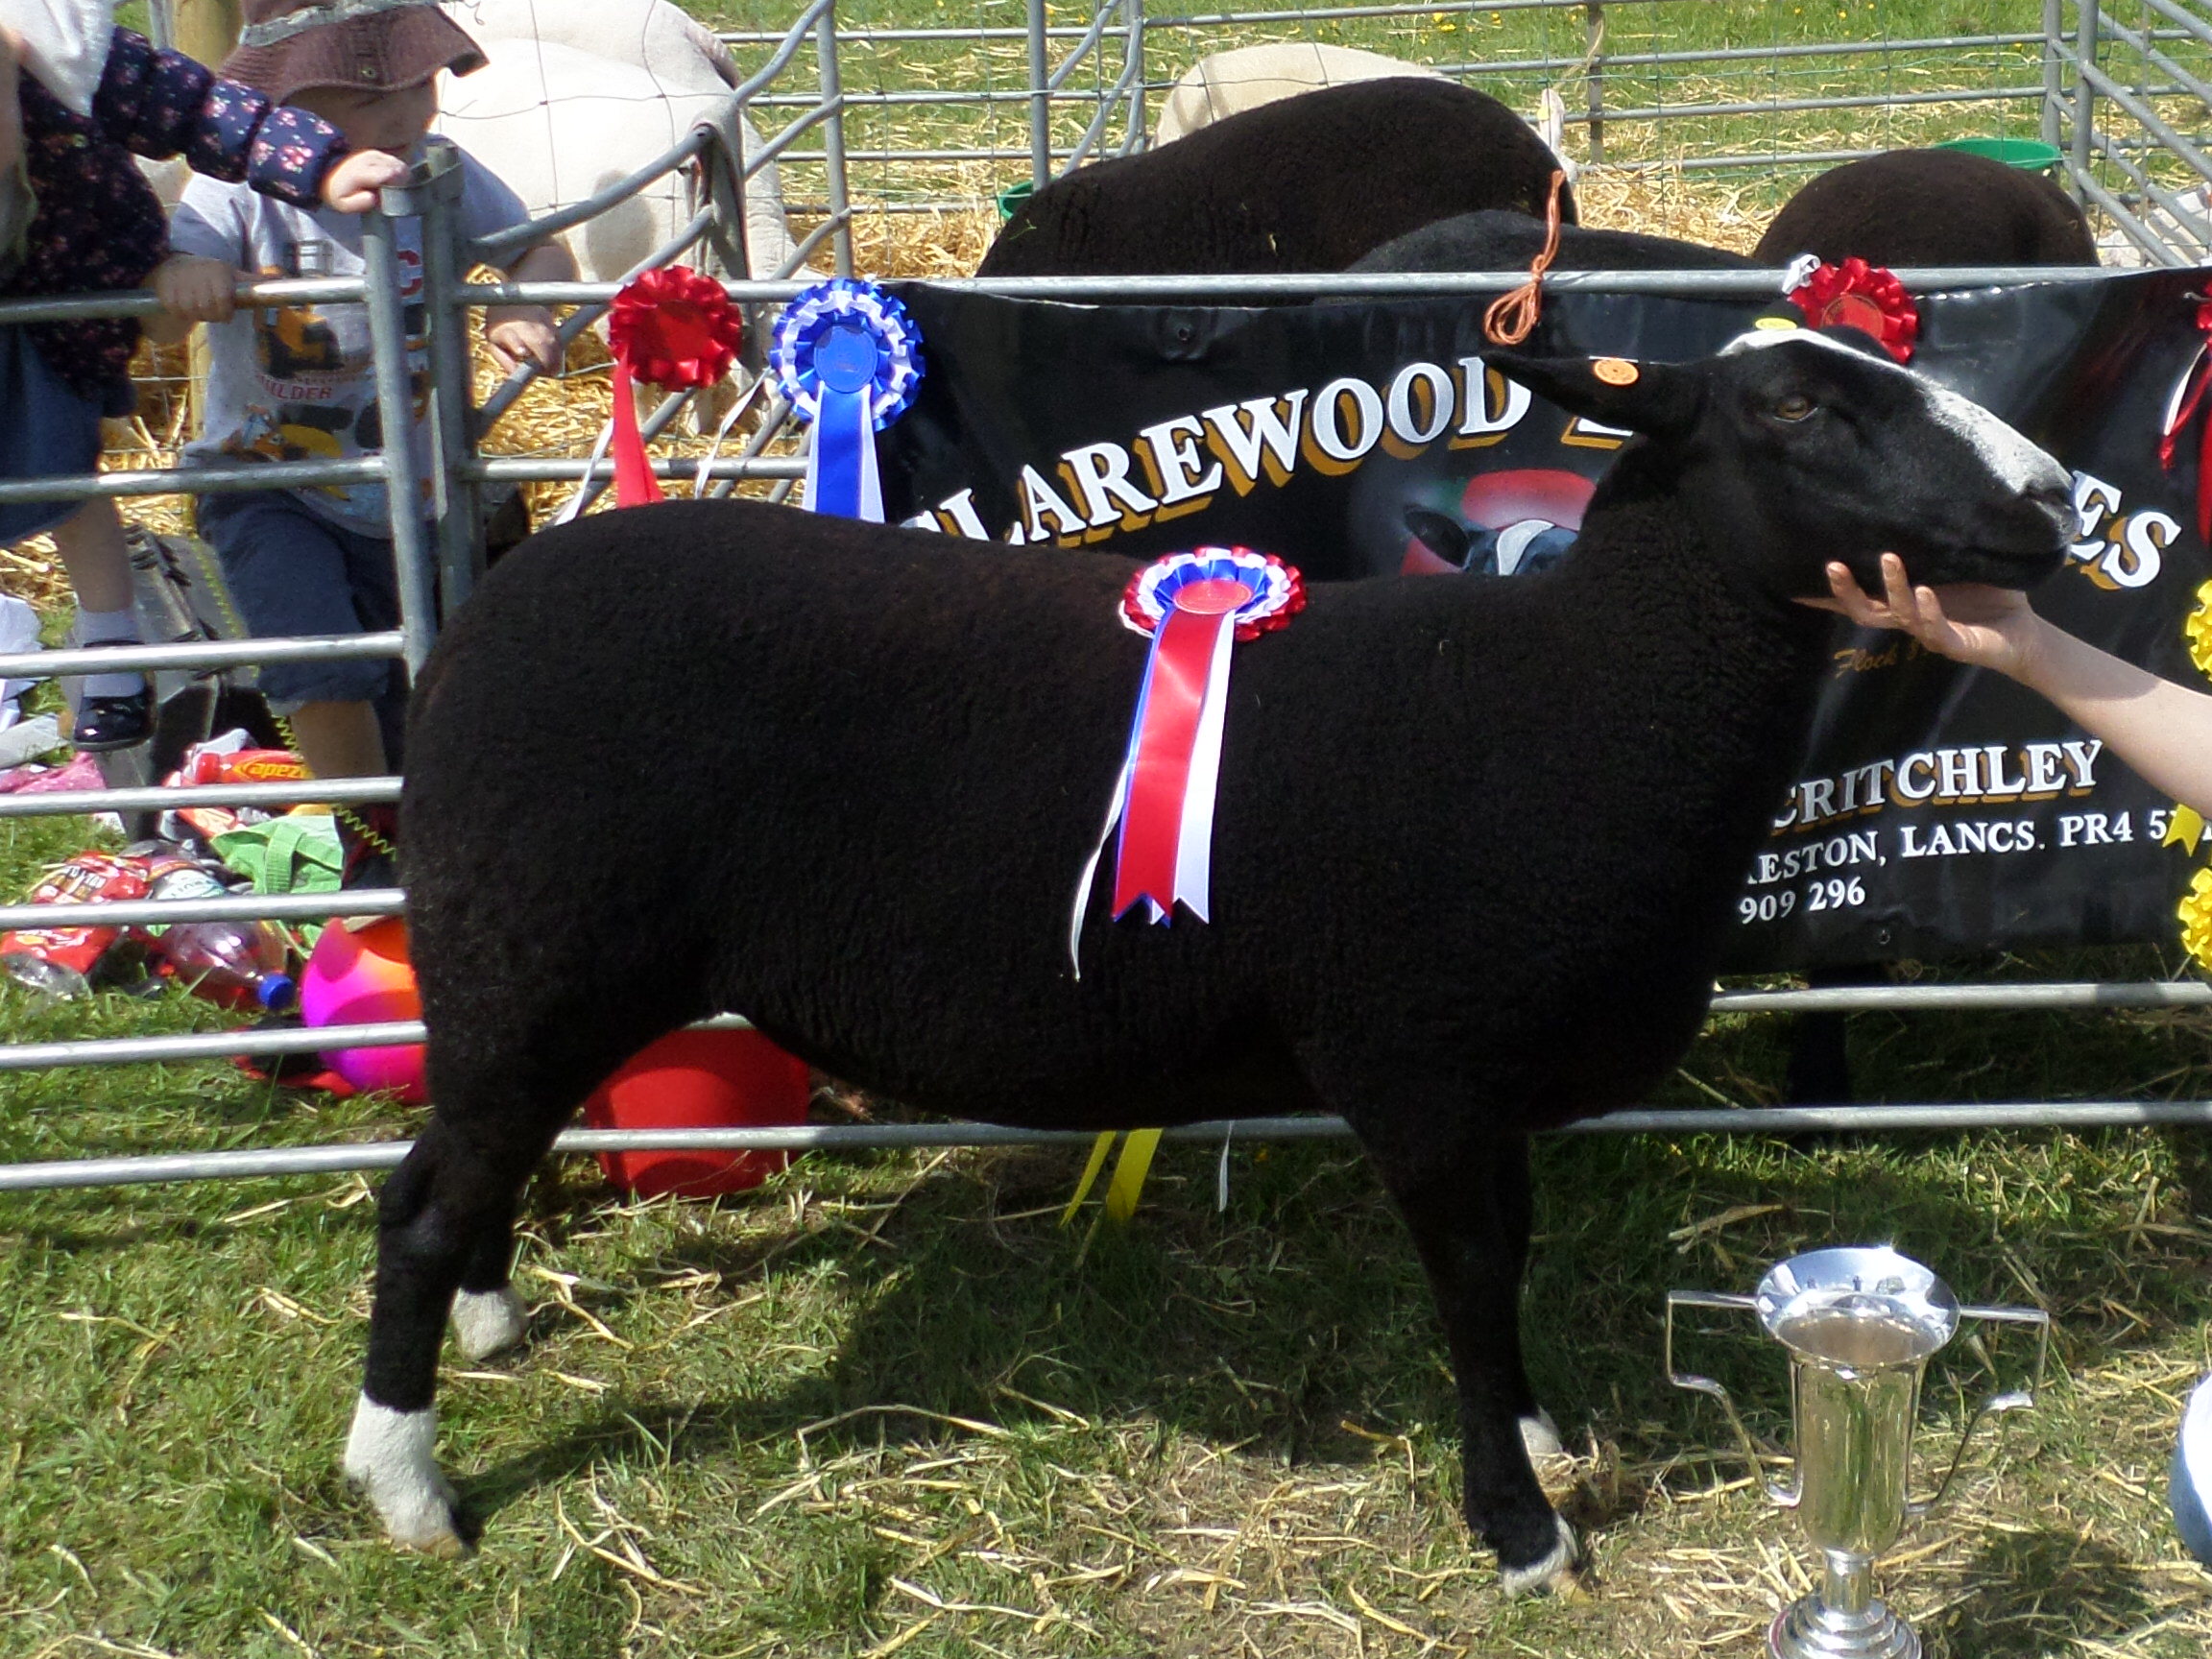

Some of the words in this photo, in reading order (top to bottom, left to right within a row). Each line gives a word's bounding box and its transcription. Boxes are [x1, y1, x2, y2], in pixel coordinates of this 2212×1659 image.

[899, 356, 1532, 545] LAREWOOD
[1746, 830, 1887, 885] ESTON,
[1900, 819, 2046, 858] LANCS.
[2059, 811, 2134, 847] PR4
[1739, 889, 1796, 925] 909
[1809, 876, 1866, 911] 296
